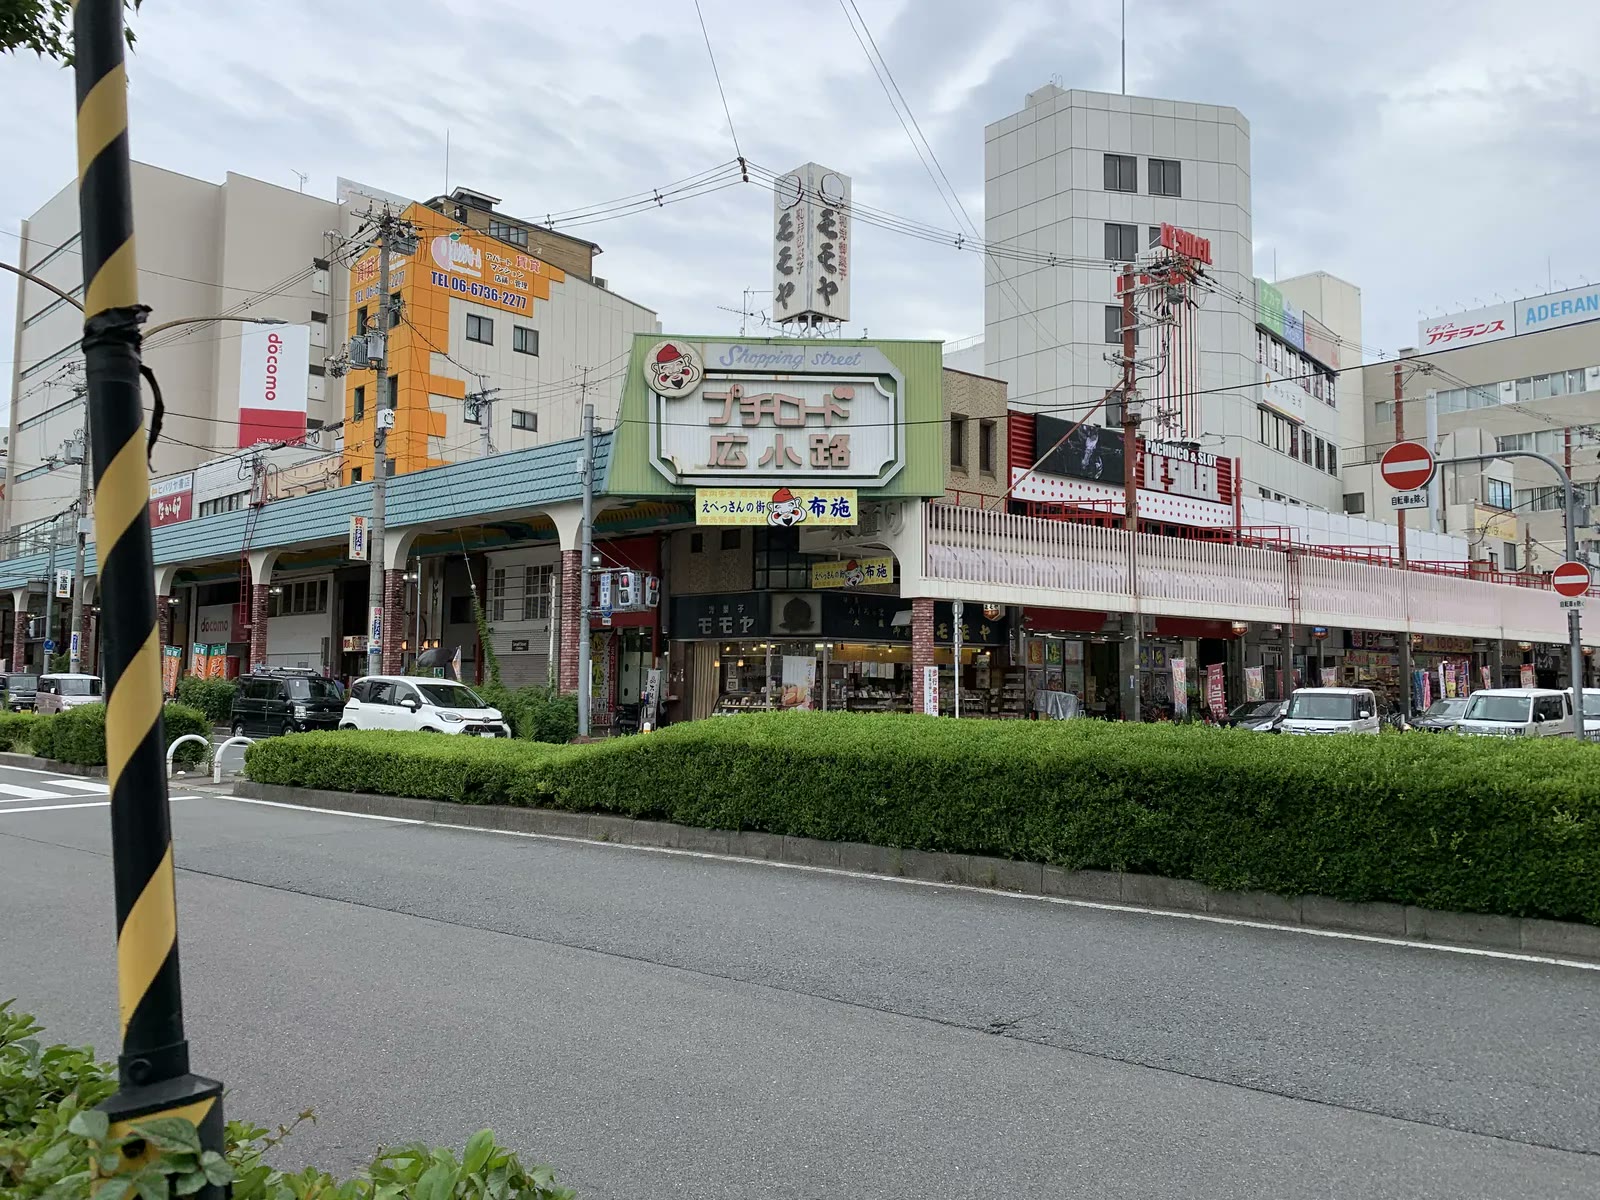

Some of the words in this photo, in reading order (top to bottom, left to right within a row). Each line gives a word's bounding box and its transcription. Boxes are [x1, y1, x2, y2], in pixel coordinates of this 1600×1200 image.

[431, 271, 449, 288] TEL
[451, 276, 527, 309] 06-6736-2277
[1426, 320, 1505, 346] アデランス
[265, 333, 283, 401] docomo
[719, 345, 805, 370] Shopping
[811, 352, 862, 367] street
[702, 383, 856, 427] プチロード
[706, 433, 851, 468] 広小路
[1145, 441, 1190, 462] PACHINCO
[1190, 452, 1197, 463] &
[1198, 452, 1218, 468] SLOT
[158, 477, 191, 494] ヒバリヤ書店
[702, 499, 766, 514] えべっさんの街
[808, 496, 852, 518] 布施
[1391, 494, 1425, 506] 自転車を除く
[865, 563, 888, 579] 布施
[201, 616, 228, 632] docomo
[698, 616, 755, 634] モモヤ
